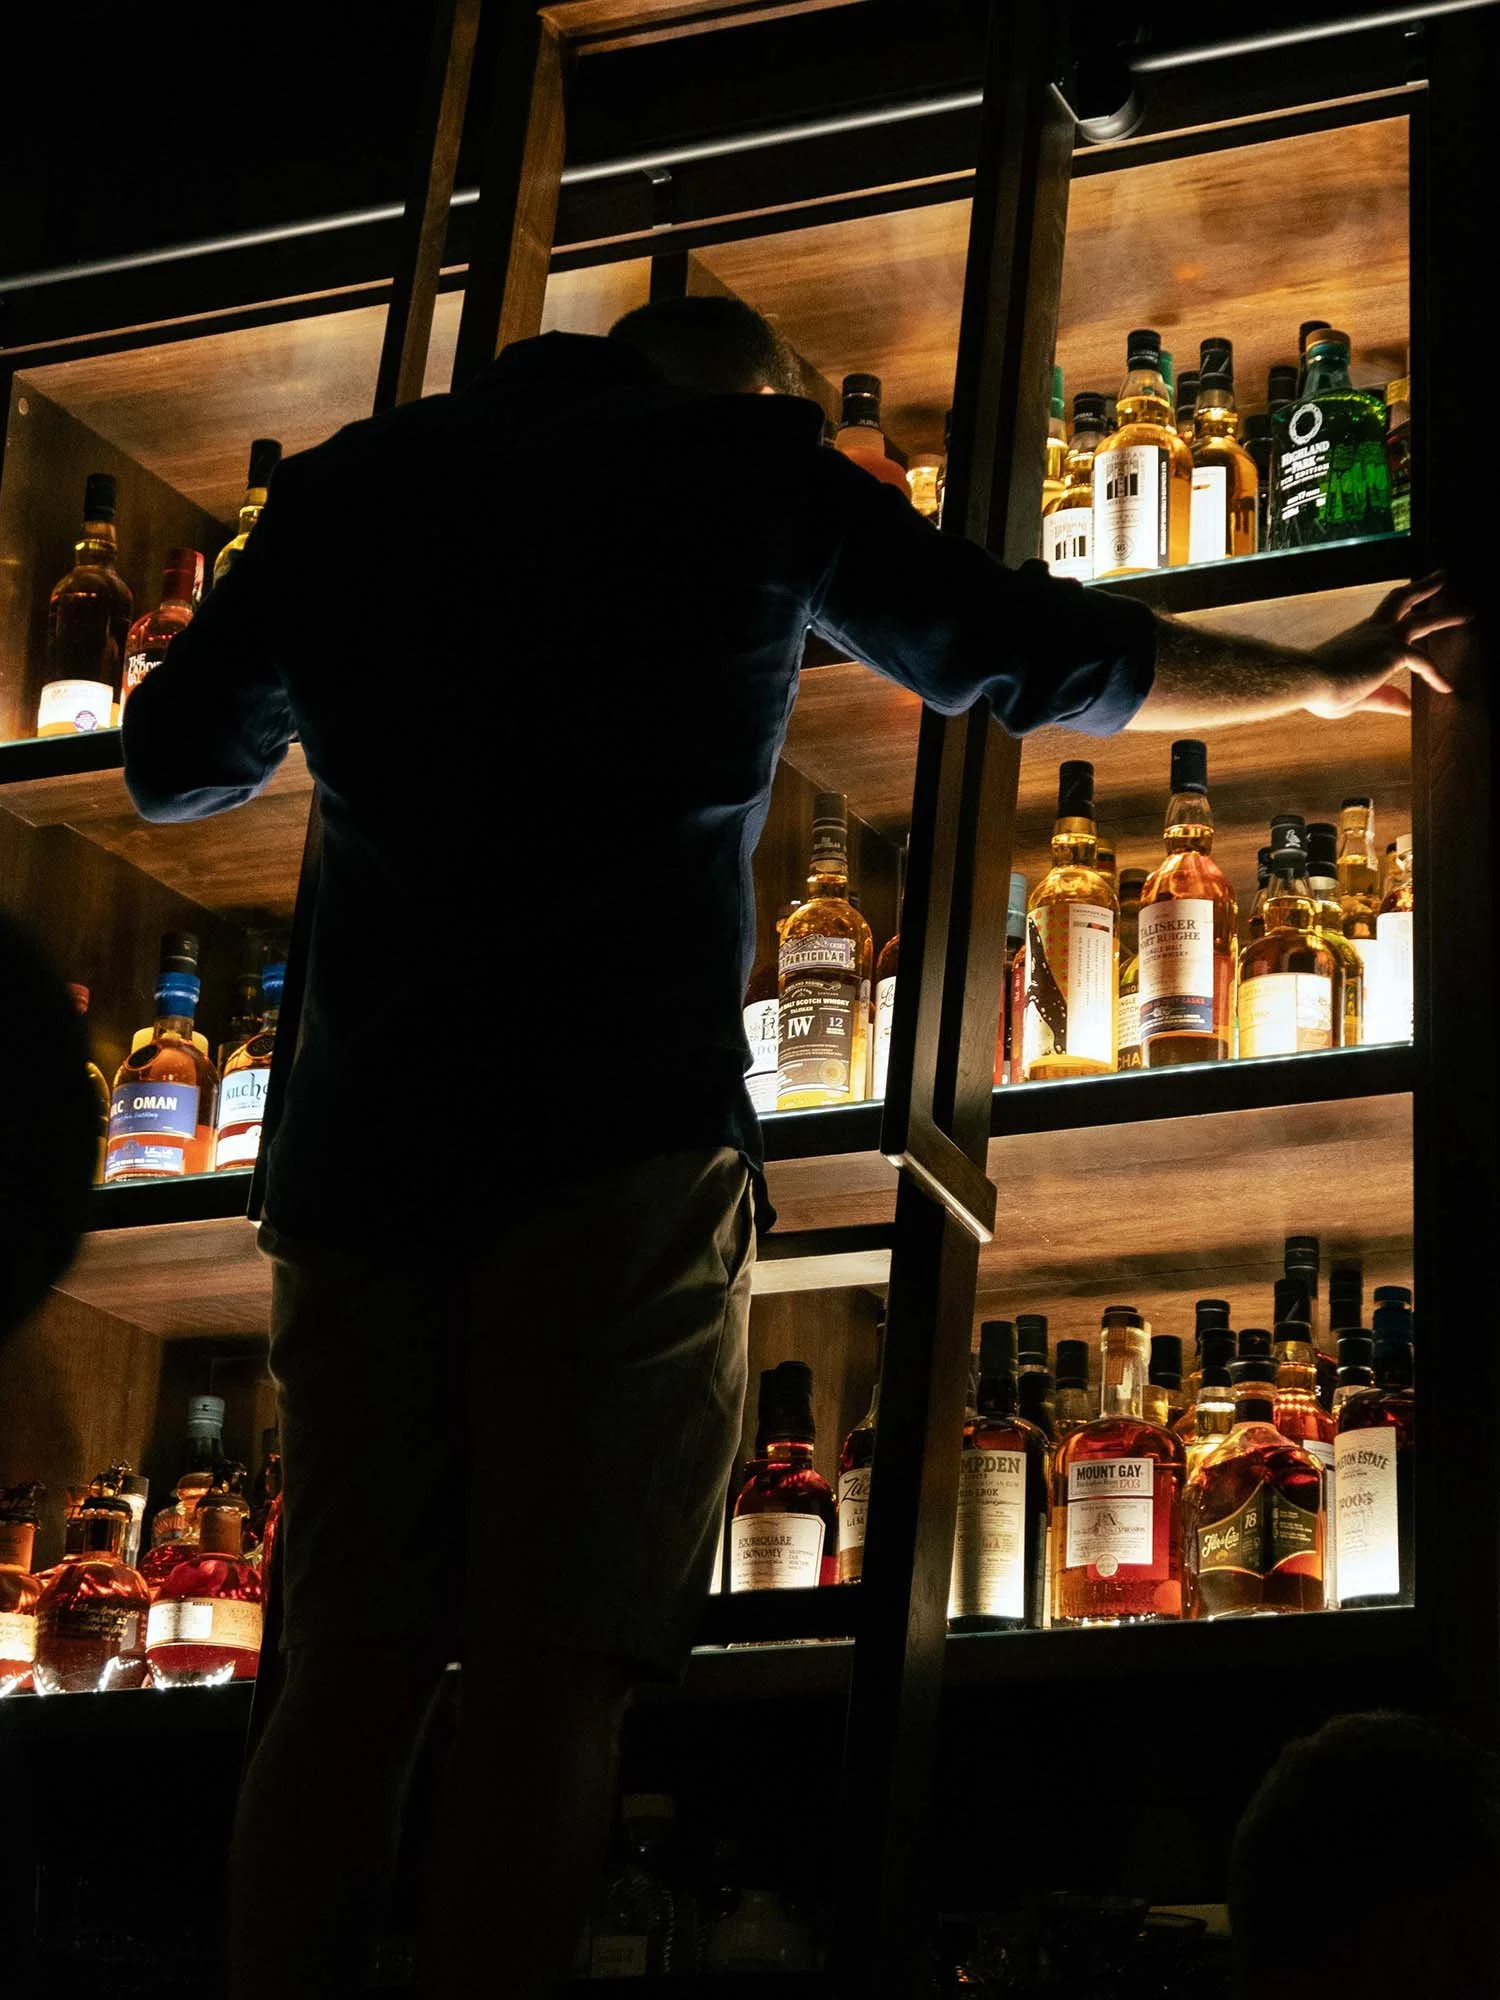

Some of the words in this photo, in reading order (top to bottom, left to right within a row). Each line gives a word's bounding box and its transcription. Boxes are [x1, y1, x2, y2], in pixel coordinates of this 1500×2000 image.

[1281, 440, 1330, 468] HIGHLAND
[1291, 455, 1317, 474] PARK
[129, 652, 147, 667] THE
[128, 661, 163, 676] LADD
[1140, 919, 1196, 938] TALISKER
[1156, 931, 1200, 943] RUIGHE
[785, 950, 845, 966] PARTICULAR
[796, 998, 822, 1006] SCOTCH
[823, 998, 850, 1006] WHISKY
[829, 1016, 844, 1028] 12
[959, 1455, 1021, 1474] MPDEN
[1357, 1450, 1390, 1470] ESTATE
[1077, 1464, 1116, 1481] MOUNT
[1118, 1464, 1141, 1478] GAY
[1245, 1512, 1257, 1529] 18
